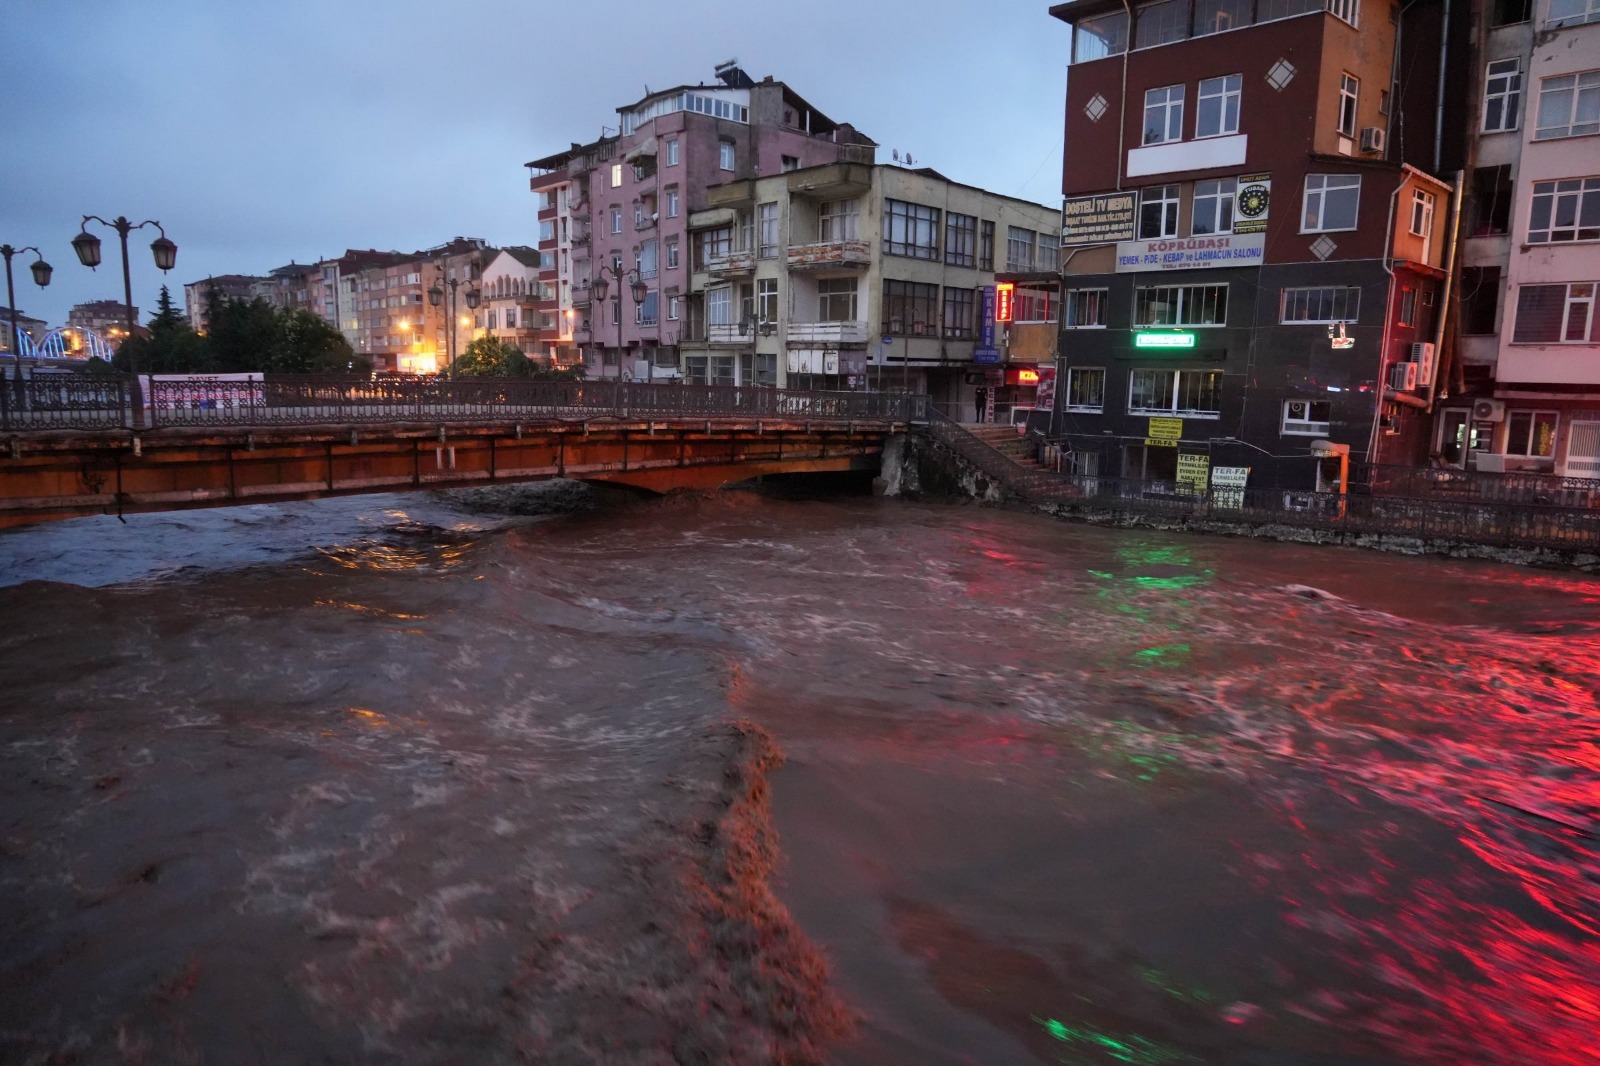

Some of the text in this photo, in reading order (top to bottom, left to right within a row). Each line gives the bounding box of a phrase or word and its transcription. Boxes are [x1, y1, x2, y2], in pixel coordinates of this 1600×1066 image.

[1096, 199, 1107, 212] TV
[1107, 196, 1133, 211] MEDYA
[1147, 238, 1230, 253] KÖPRÜBAŞI
[1119, 255, 1140, 266] YEMEK
[1163, 253, 1184, 263] KEBAP
[1186, 254, 1193, 262] ve
[1194, 250, 1232, 261] LAHMACUN
[1233, 248, 1262, 259] SALONU
[985, 297, 993, 346] KAMER
[1178, 455, 1209, 463] TER-FA
